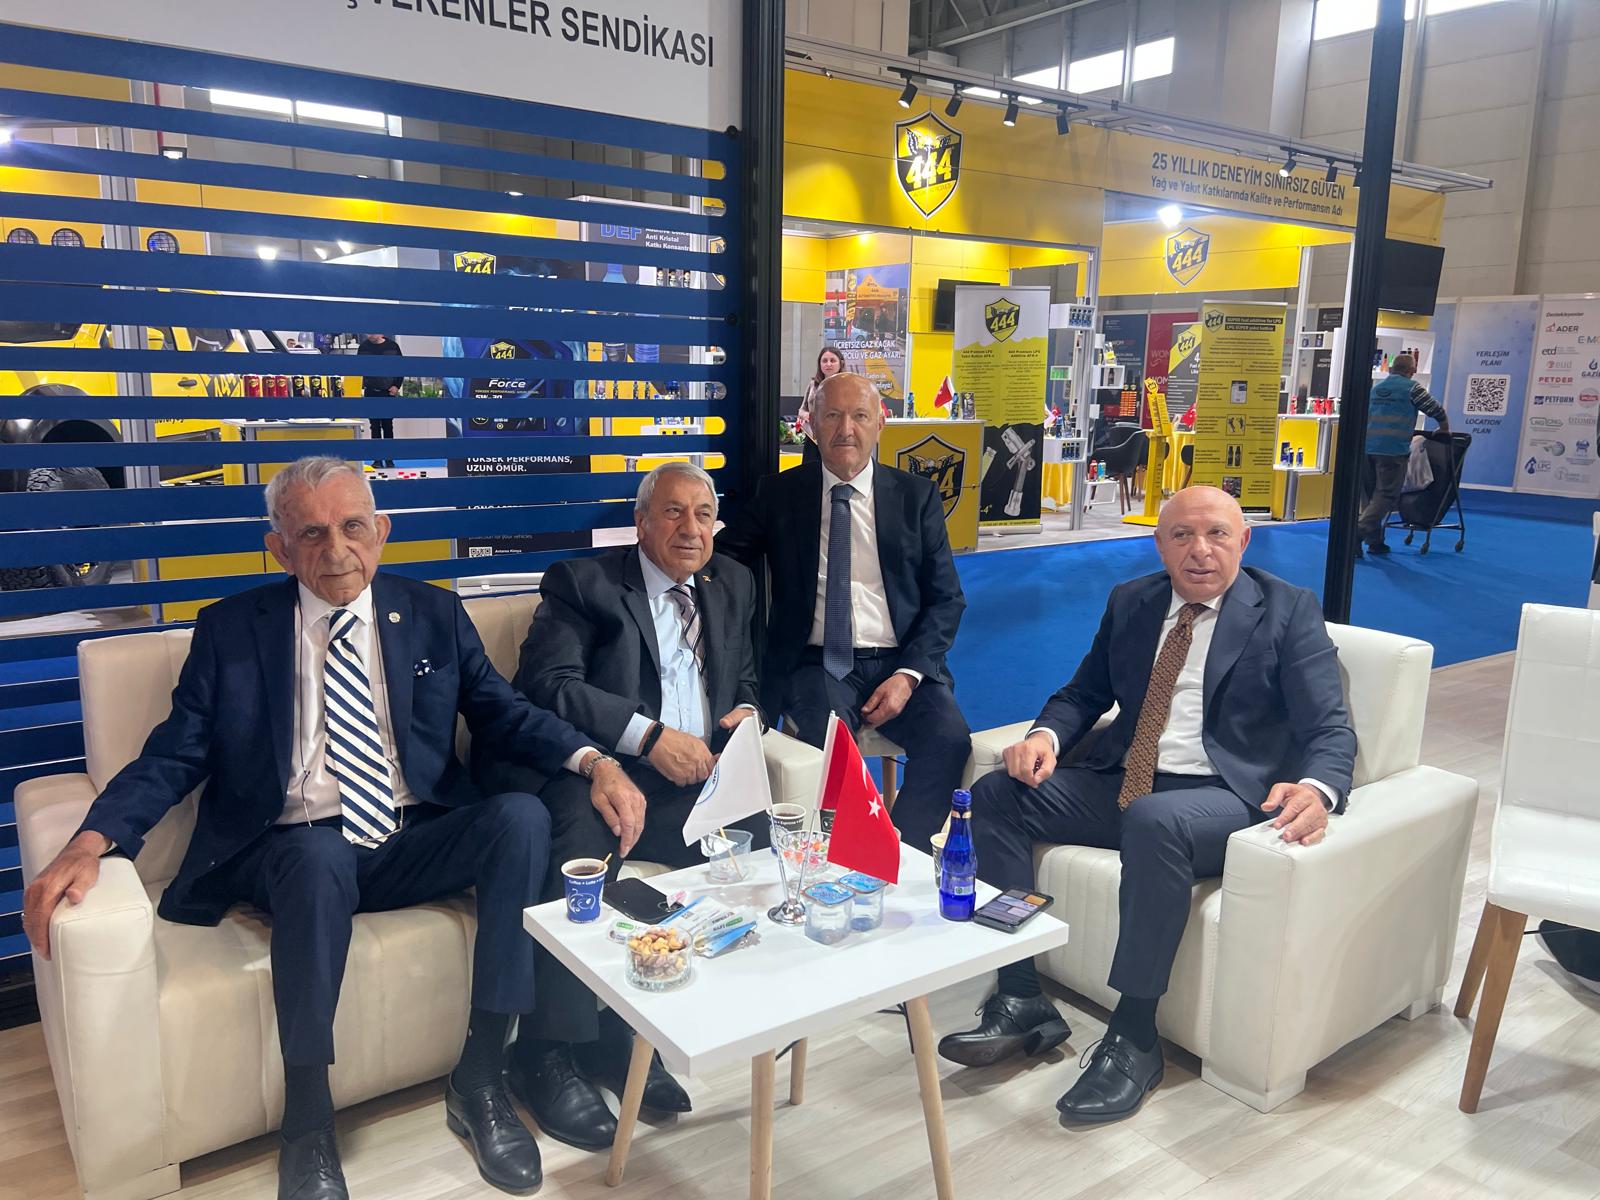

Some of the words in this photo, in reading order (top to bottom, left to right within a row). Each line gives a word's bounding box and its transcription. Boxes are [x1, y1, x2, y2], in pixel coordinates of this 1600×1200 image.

[347, 0, 551, 38] ENLER
[561, 6, 714, 68] SENDİKASI
[906, 147, 952, 190] 444
[1152, 152, 1168, 170] 25
[1171, 155, 1209, 177] YILLIK
[1212, 162, 1262, 187] DENEYİM
[1264, 171, 1309, 194] SINIRSIZ
[1311, 177, 1346, 201] GÜVEN
[1151, 175, 1167, 191] Yağ
[1168, 180, 1178, 191] ve
[1181, 179, 1201, 194] Yakıt
[1202, 184, 1249, 202] Katkılarında
[1250, 191, 1273, 206] Kalite
[1273, 197, 1281, 207] ve
[1284, 196, 1331, 214] Performansın
[1331, 204, 1343, 216] Adı
[645, 233, 659, 241] Anti
[659, 235, 680, 243] Kristal
[1172, 243, 1203, 272] 444
[990, 310, 1016, 331] 444
[860, 351, 869, 359] VE
[870, 351, 882, 359] GAZ
[488, 379, 527, 389] Force
[466, 464, 493, 472] UZUN
[495, 462, 527, 472] ÖMÜR.
